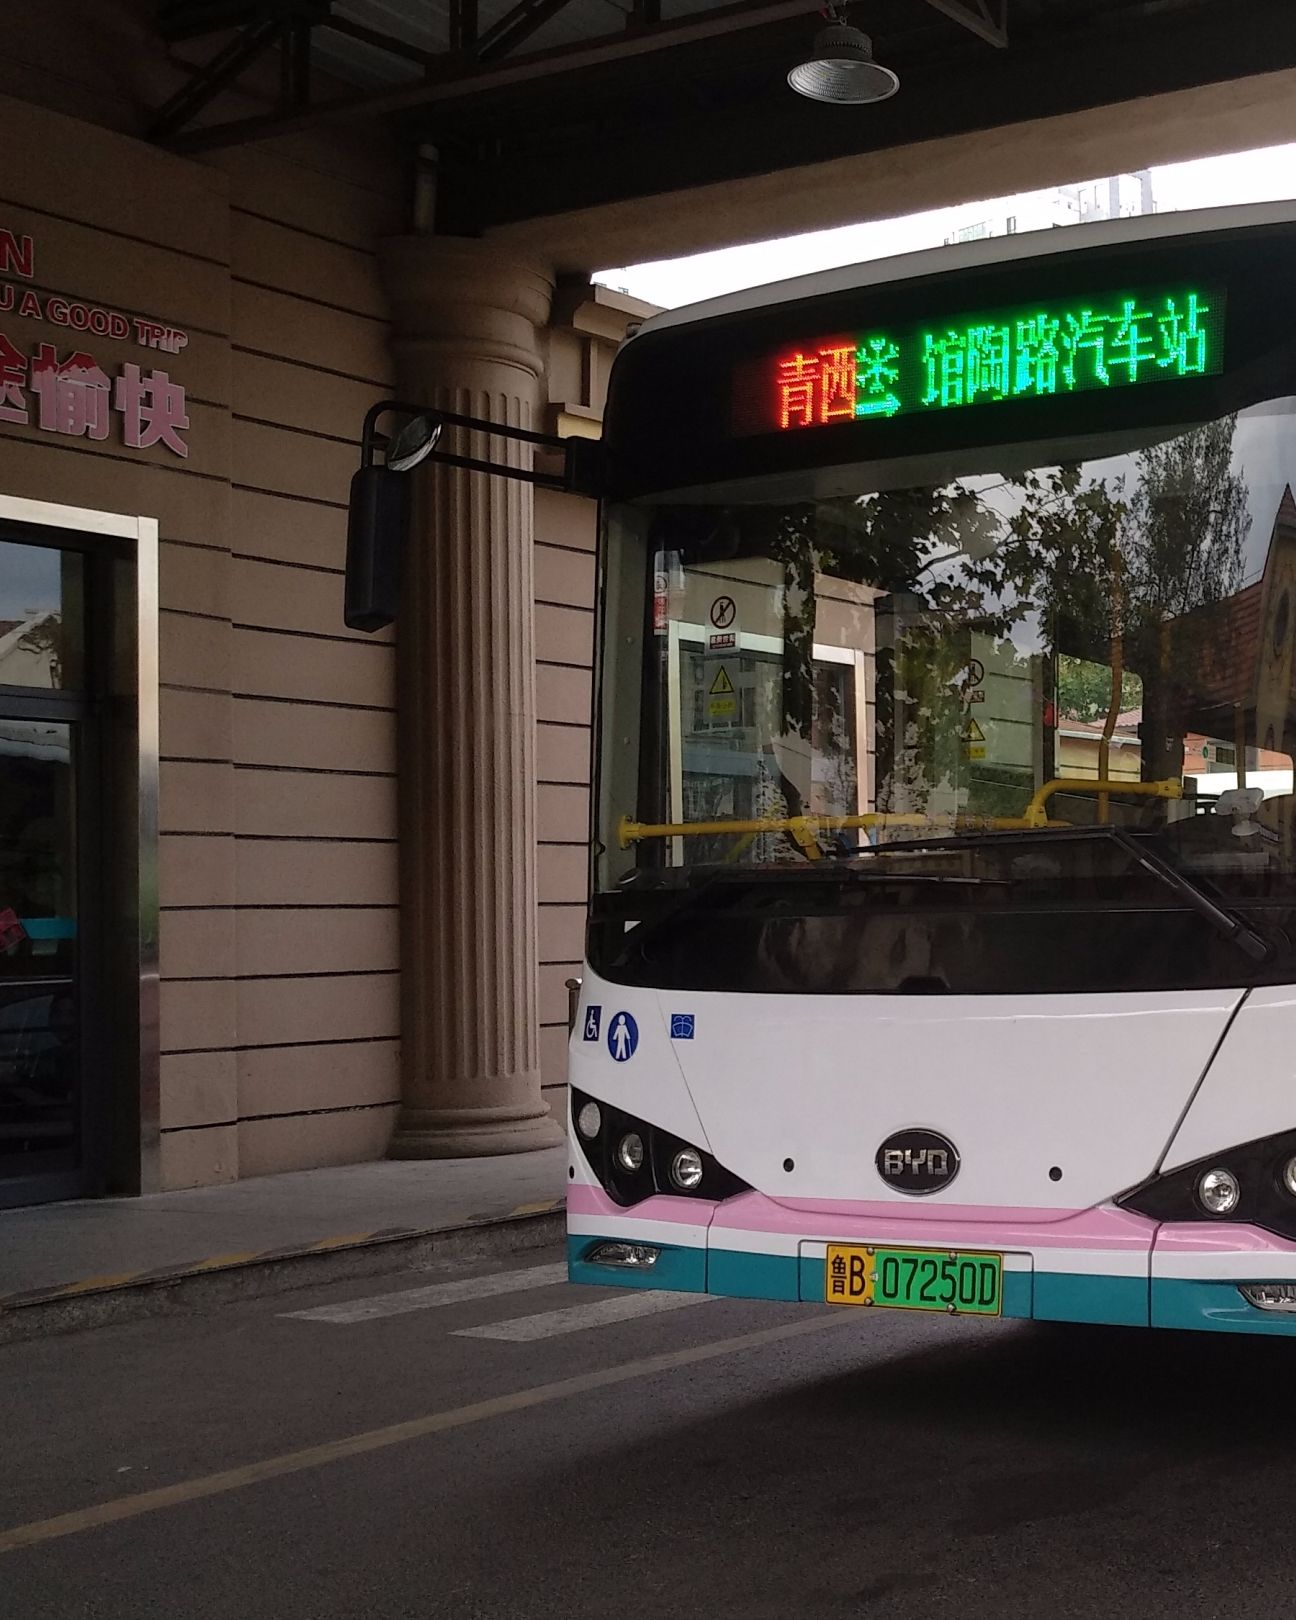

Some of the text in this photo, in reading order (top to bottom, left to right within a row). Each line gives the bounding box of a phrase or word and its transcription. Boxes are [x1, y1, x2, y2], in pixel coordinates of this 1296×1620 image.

[19, 291, 42, 319] A
[47, 298, 130, 339] GOOD
[134, 318, 188, 354] TRIP
[884, 1148, 949, 1175] BYD
